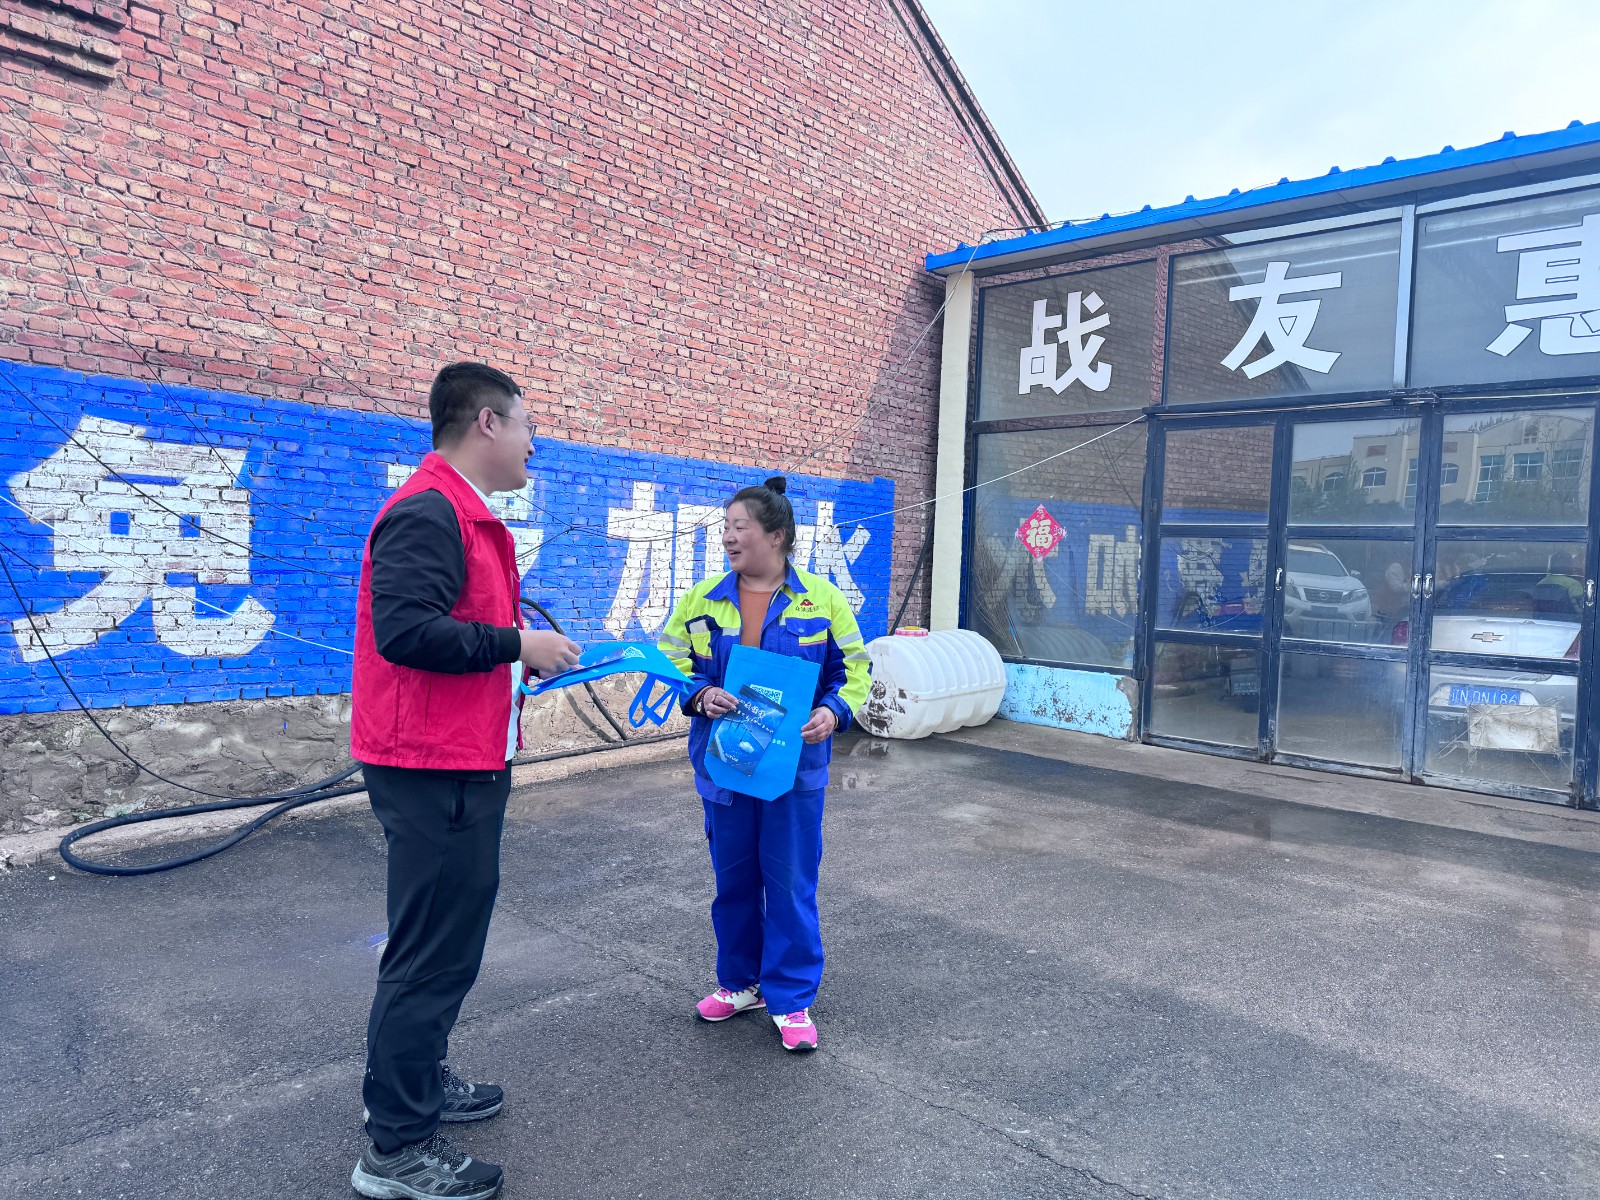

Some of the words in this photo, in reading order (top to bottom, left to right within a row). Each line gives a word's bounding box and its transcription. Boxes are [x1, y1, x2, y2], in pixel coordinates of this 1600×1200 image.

[8, 416, 870, 662] 免加水
[1026, 518, 1053, 549] 福
